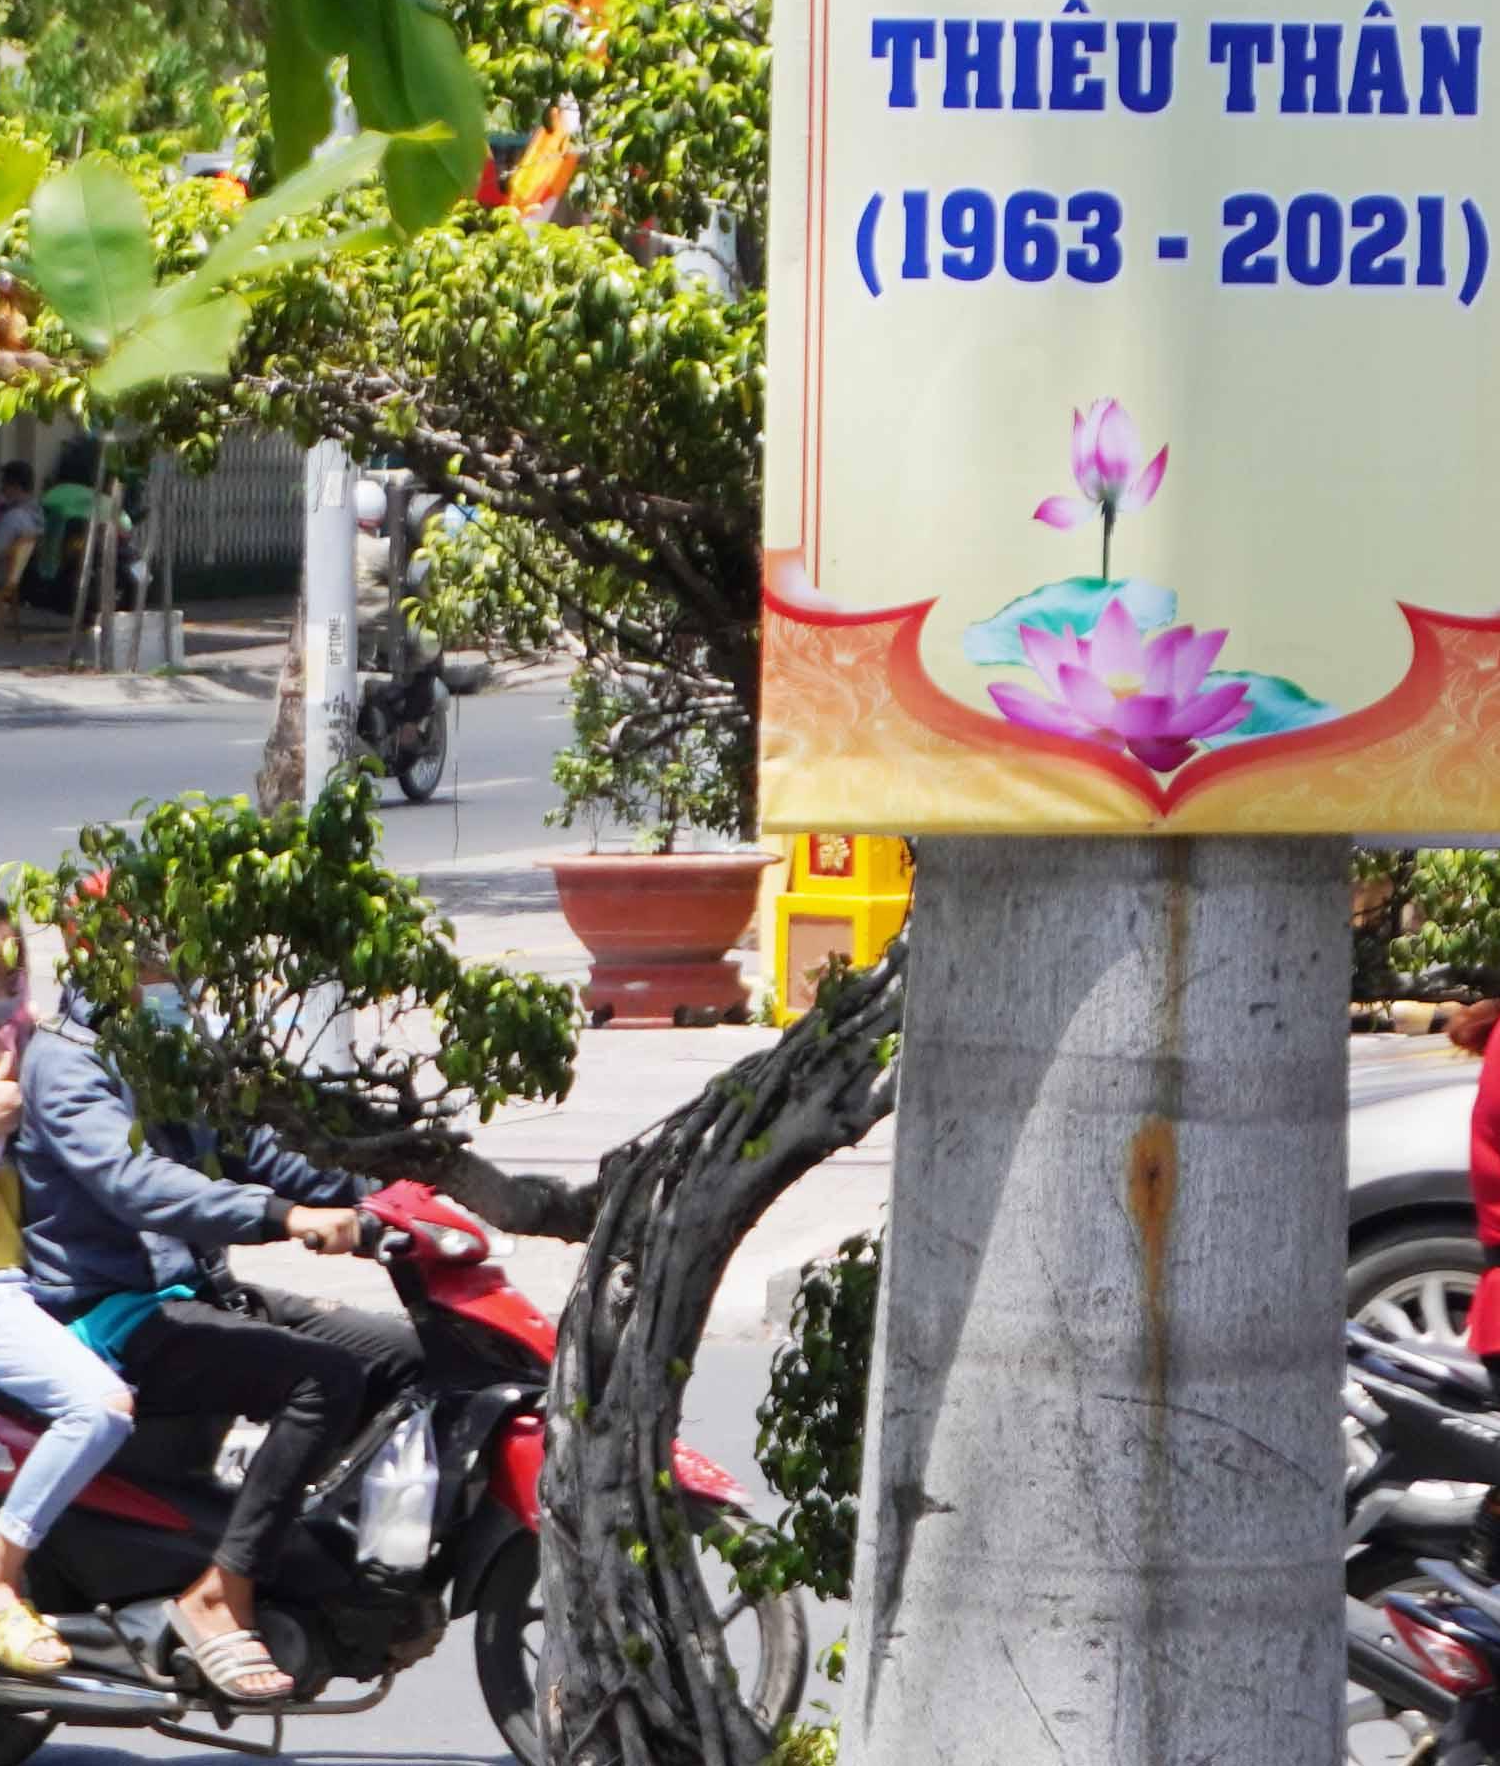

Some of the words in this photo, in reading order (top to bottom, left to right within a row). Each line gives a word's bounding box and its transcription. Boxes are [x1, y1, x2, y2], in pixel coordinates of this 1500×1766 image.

[1209, 0, 1482, 116] THÂN
[856, 189, 1122, 297] (1963
[1158, 236, 1188, 259] -
[1221, 193, 1489, 306] 2021)
